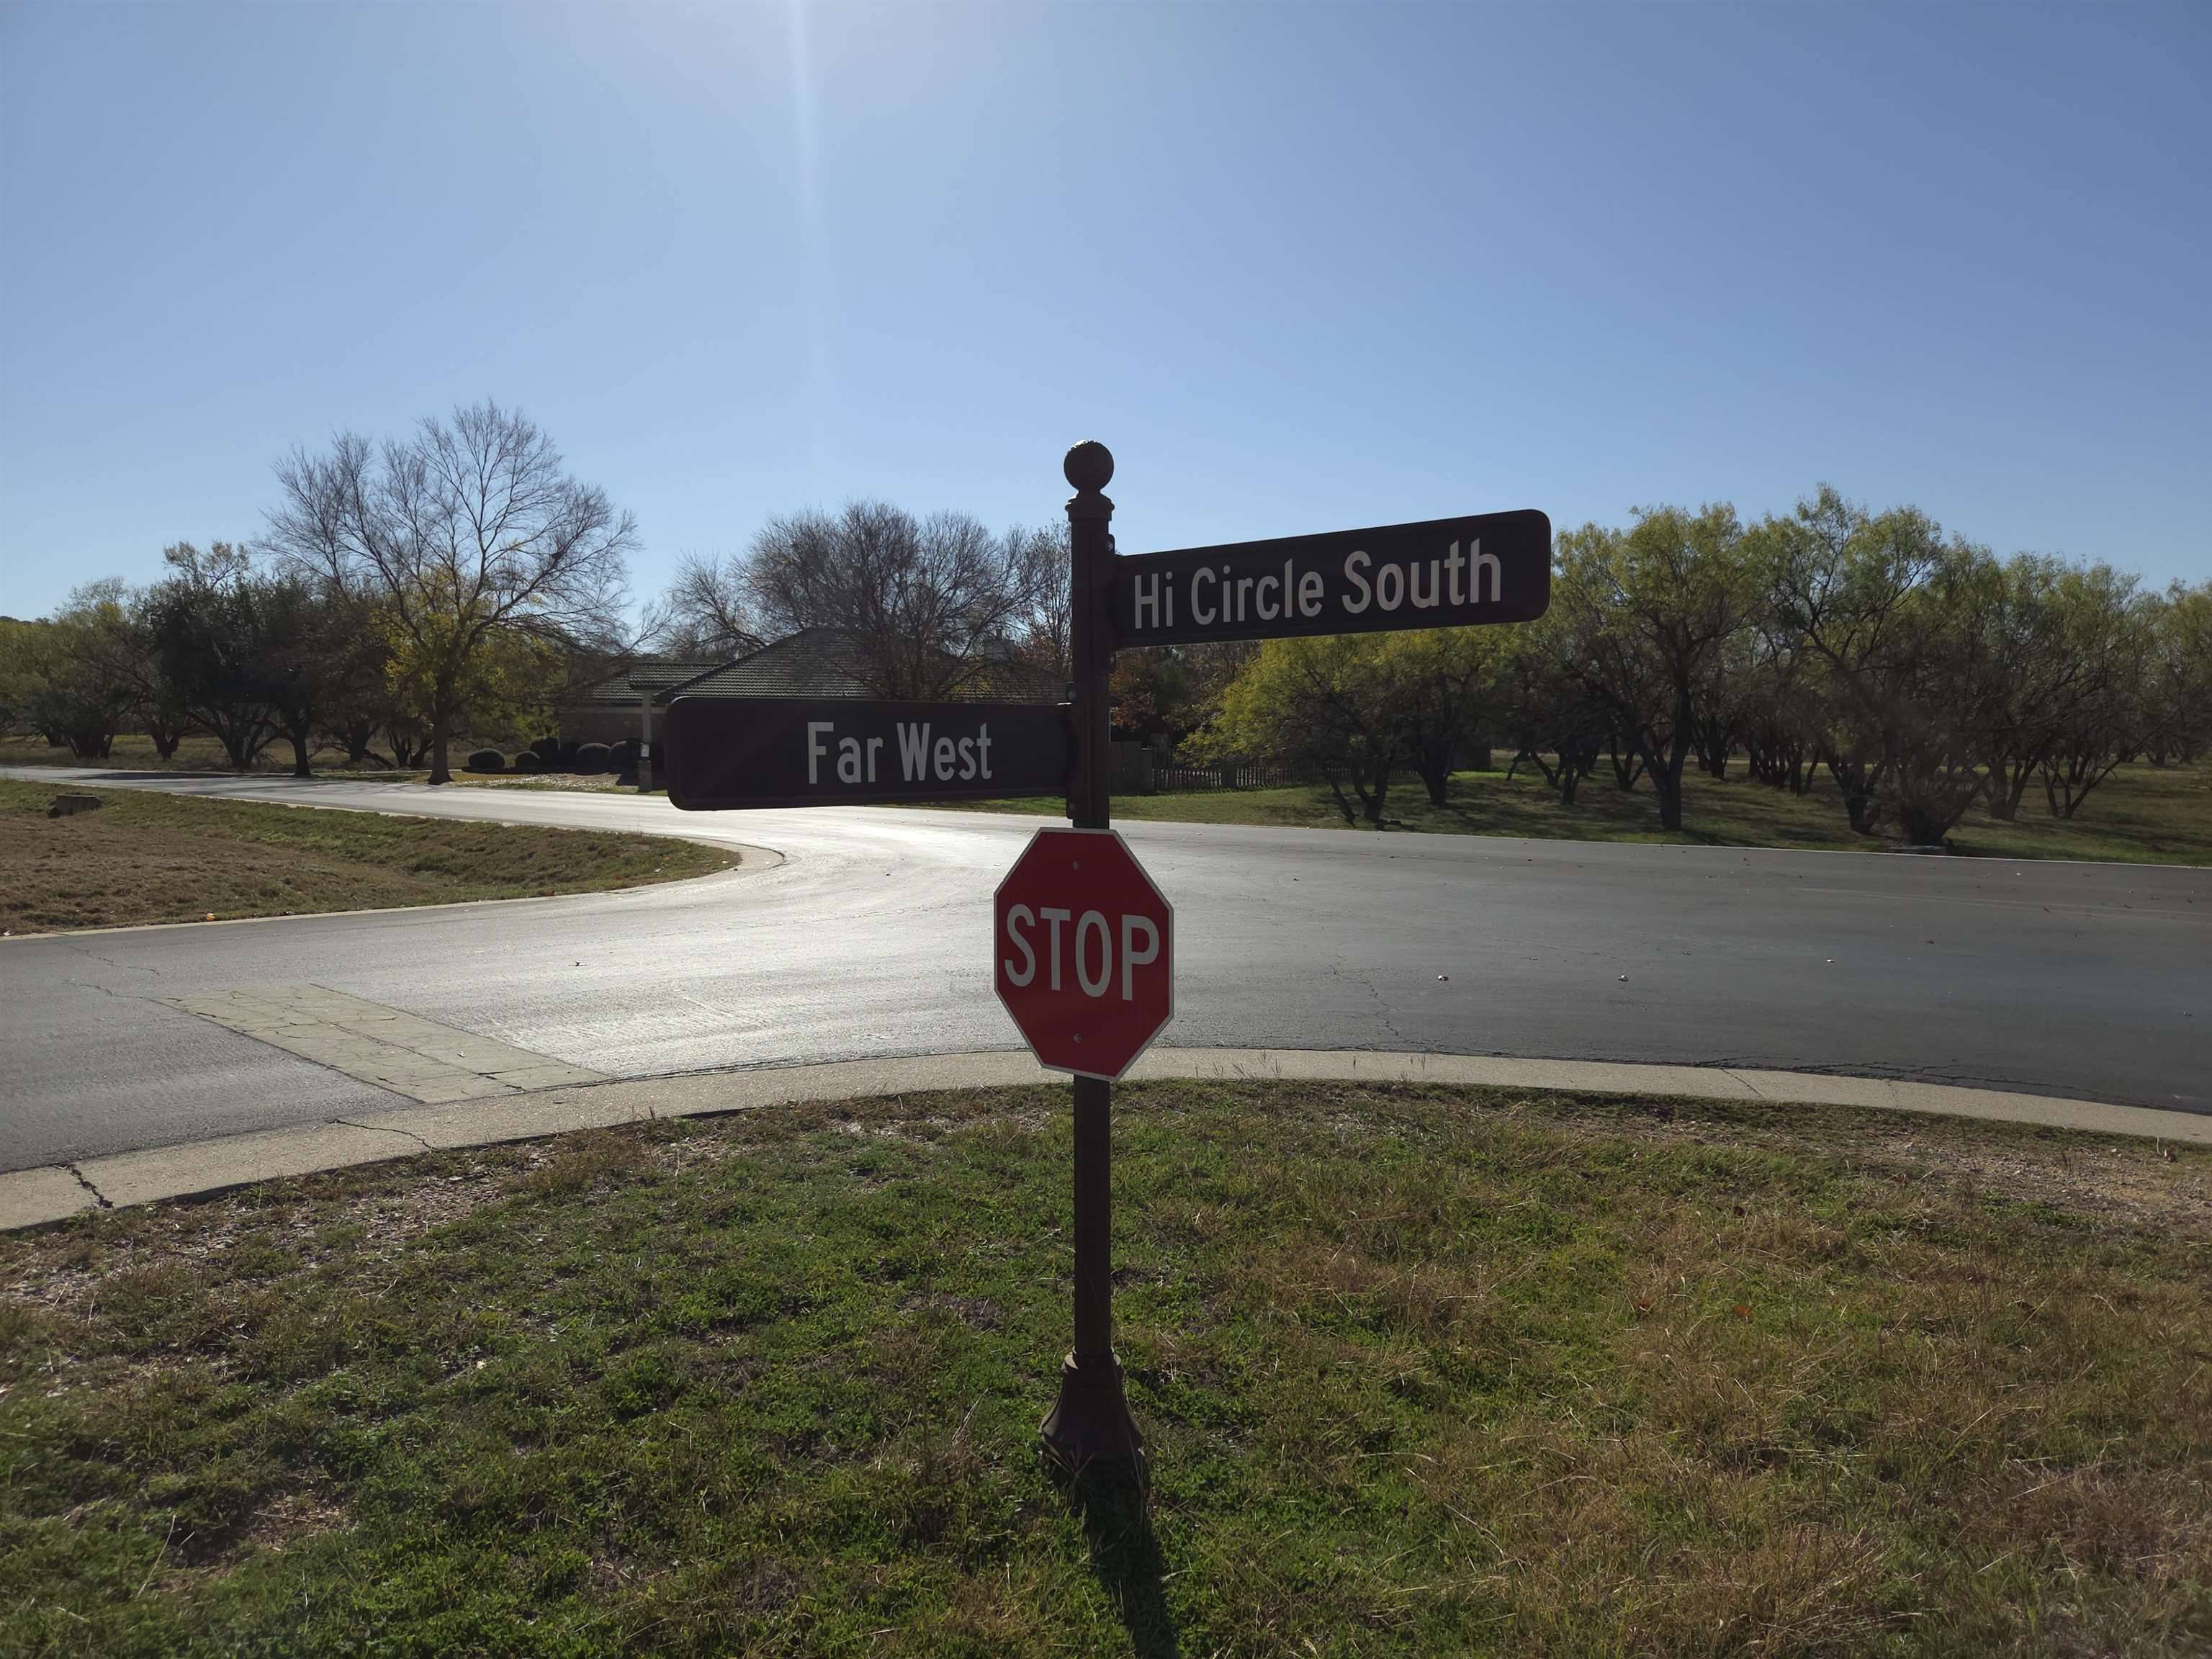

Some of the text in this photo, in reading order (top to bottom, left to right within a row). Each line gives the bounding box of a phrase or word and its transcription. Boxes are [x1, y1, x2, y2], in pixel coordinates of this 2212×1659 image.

[1134, 538, 1501, 629] Hi Circle South
[806, 721, 992, 784] Far West
[1004, 904, 1160, 1002] STOP
